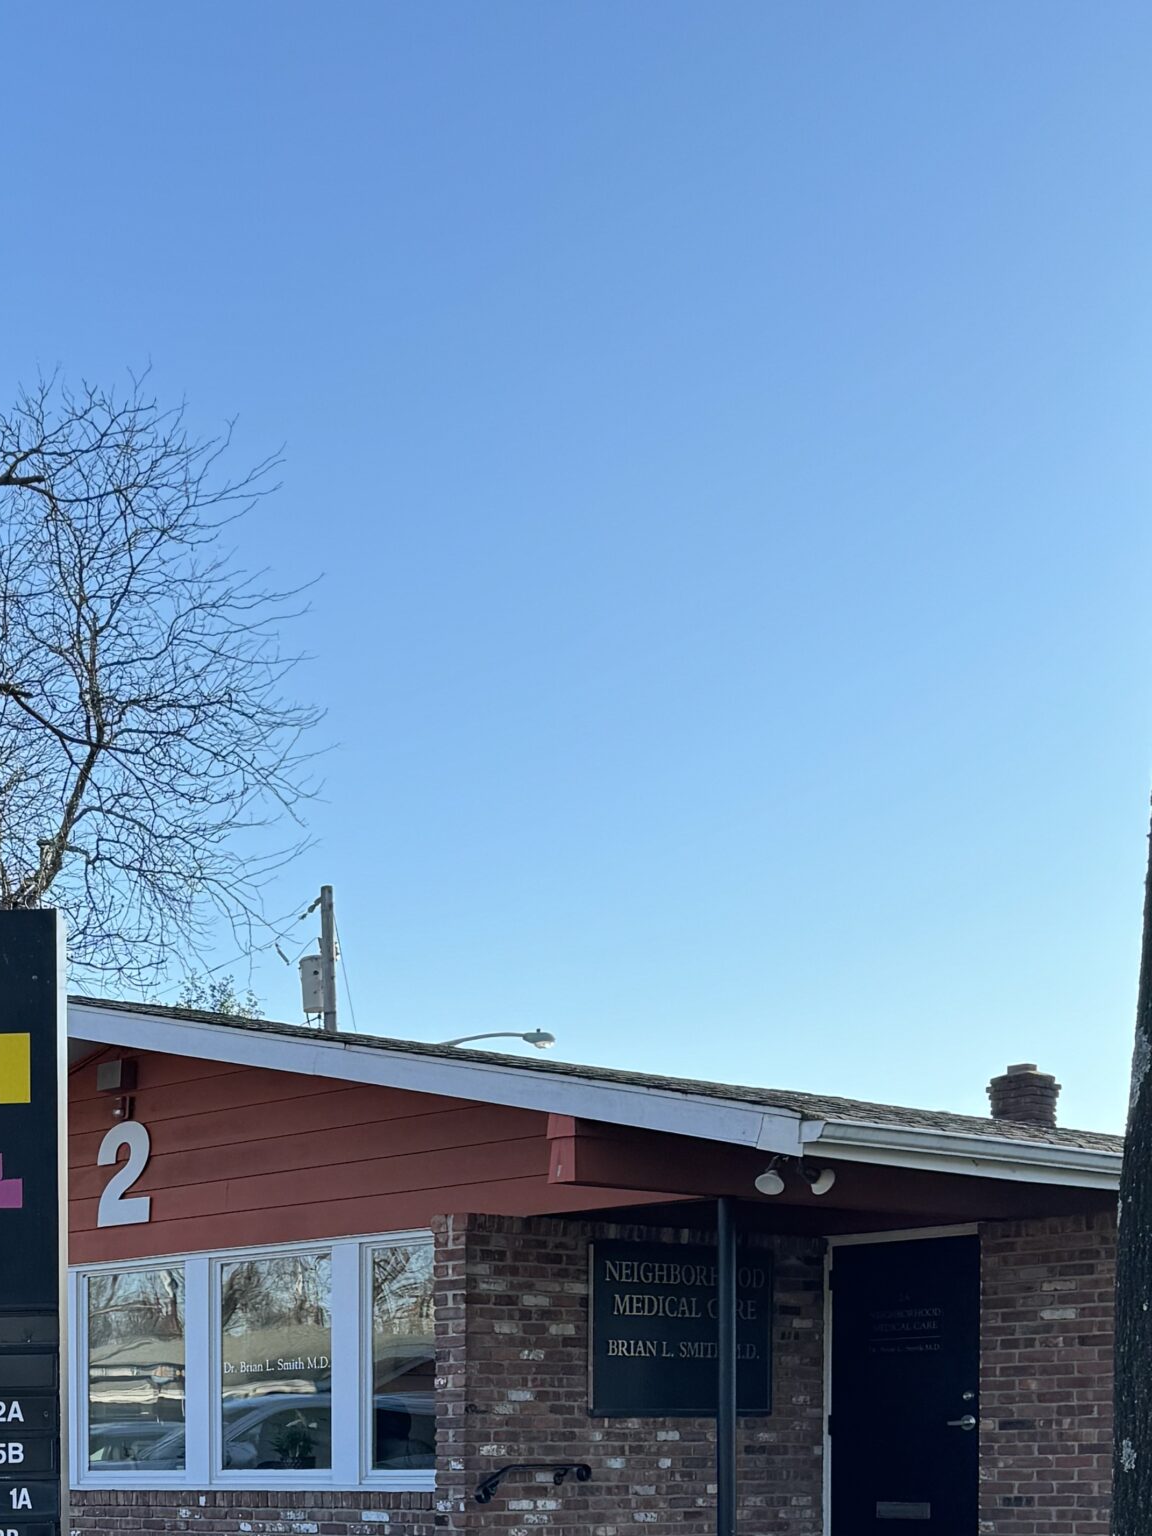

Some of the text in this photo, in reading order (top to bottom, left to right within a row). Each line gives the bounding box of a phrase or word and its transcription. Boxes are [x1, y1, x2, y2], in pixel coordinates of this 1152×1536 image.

[97, 1121, 150, 1227] 2
[606, 1261, 764, 1288] NEIGHBORHOD
[613, 1294, 757, 1319] MEDICAL CRE
[608, 1340, 657, 1357] BRIAN
[662, 1342, 674, 1357] L.
[224, 1356, 330, 1373] Dr. Brian L. Smith M.D.
[9, 1487, 33, 1510] 1A
